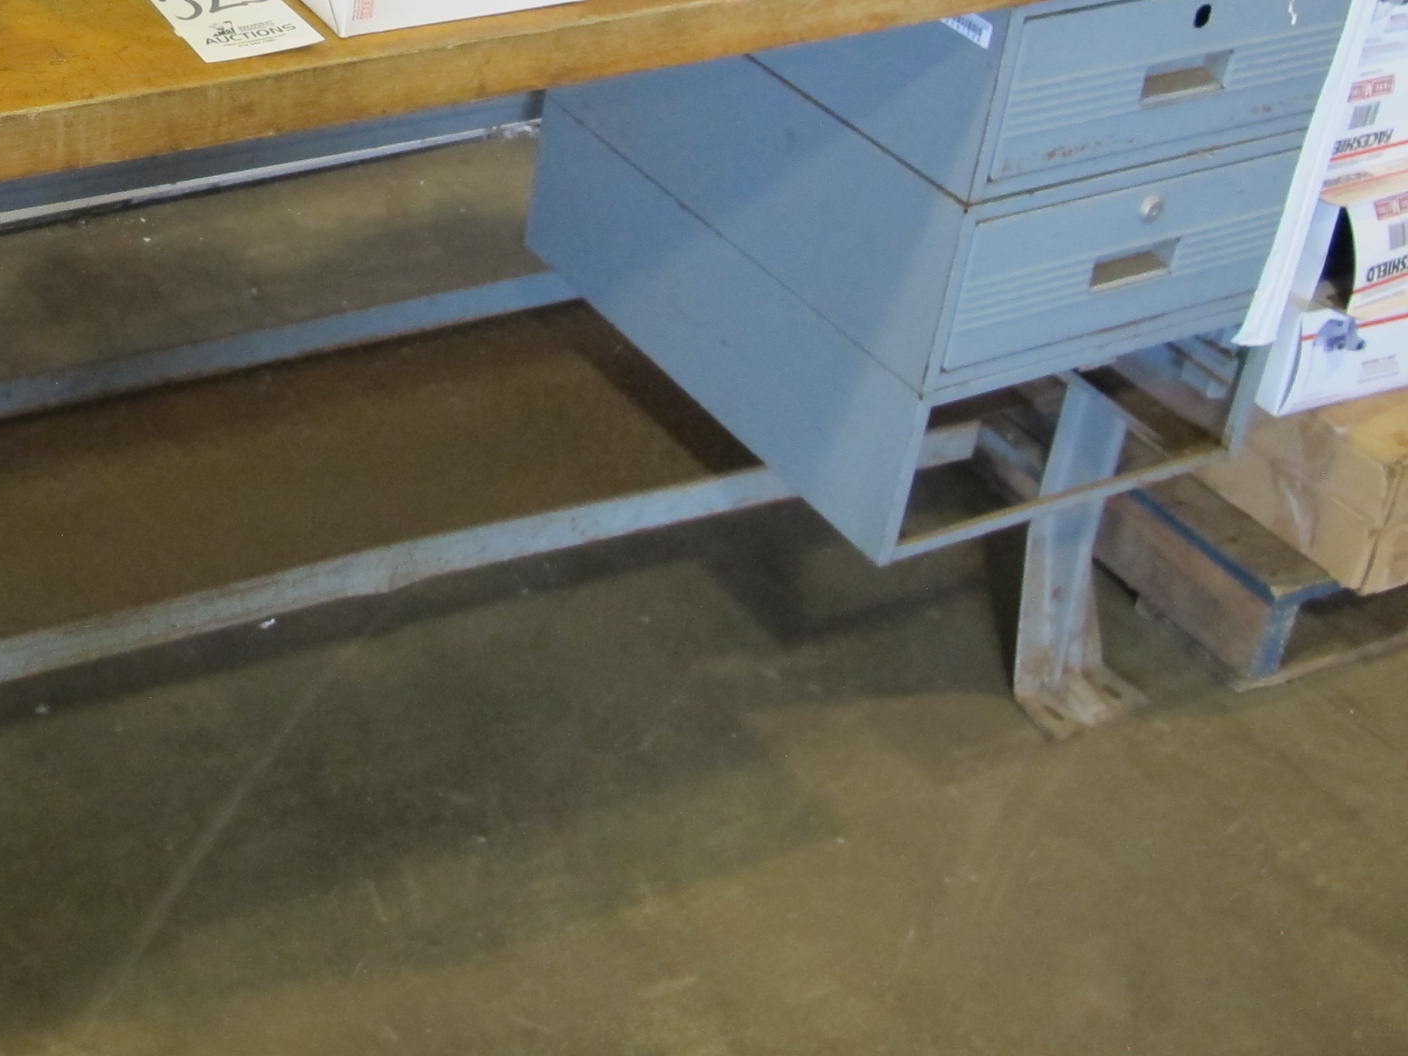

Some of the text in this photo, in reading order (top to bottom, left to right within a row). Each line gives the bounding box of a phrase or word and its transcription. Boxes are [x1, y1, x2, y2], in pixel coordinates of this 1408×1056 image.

[205, 22, 297, 46] AUCTIONS
[1332, 128, 1394, 155] FACESHIE
[1365, 254, 1408, 283] SHIELD
